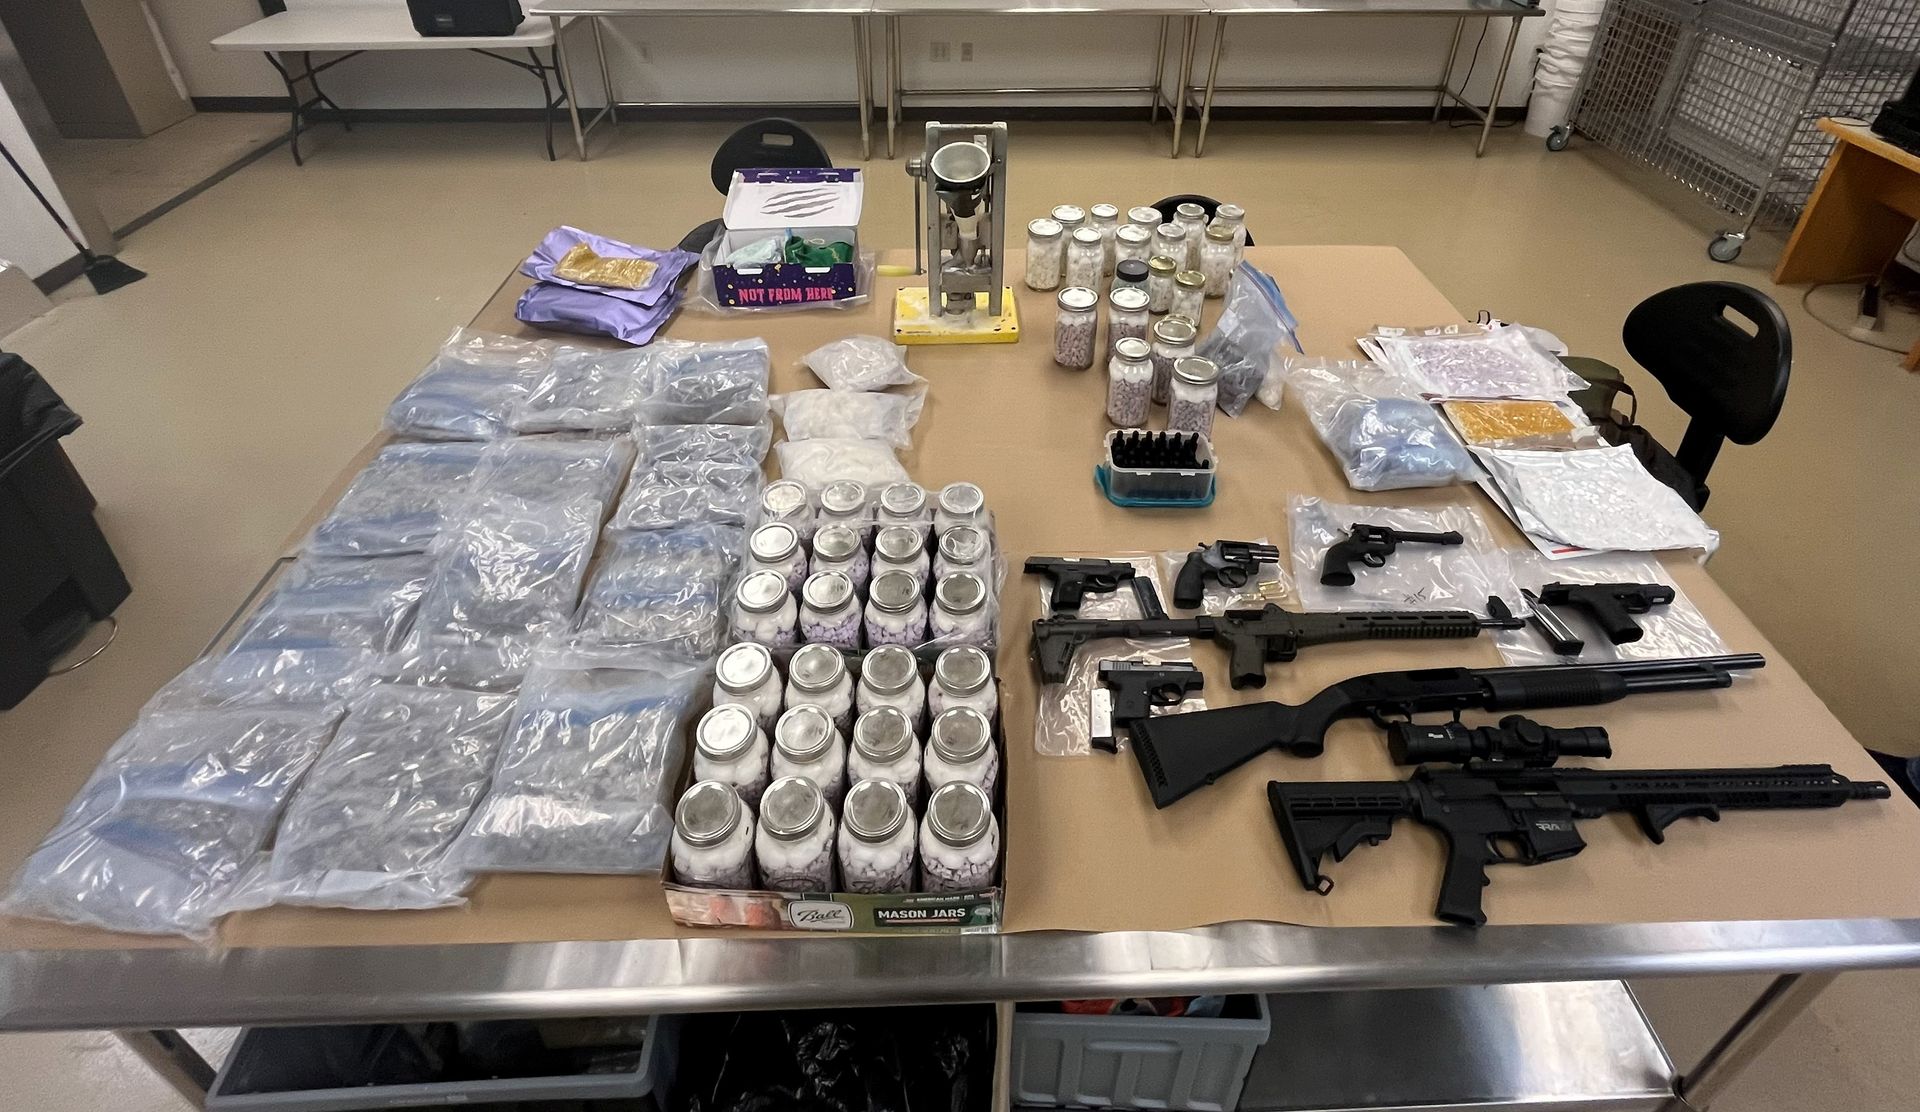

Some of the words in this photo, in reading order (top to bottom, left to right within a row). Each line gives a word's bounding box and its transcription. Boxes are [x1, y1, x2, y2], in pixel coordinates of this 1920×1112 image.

[738, 287, 765, 304] NOT
[768, 287, 803, 302] FROM
[805, 286, 833, 300] HERE
[797, 909, 842, 923] Ball
[877, 909, 927, 919] MASON
[932, 908, 966, 918] JARS
